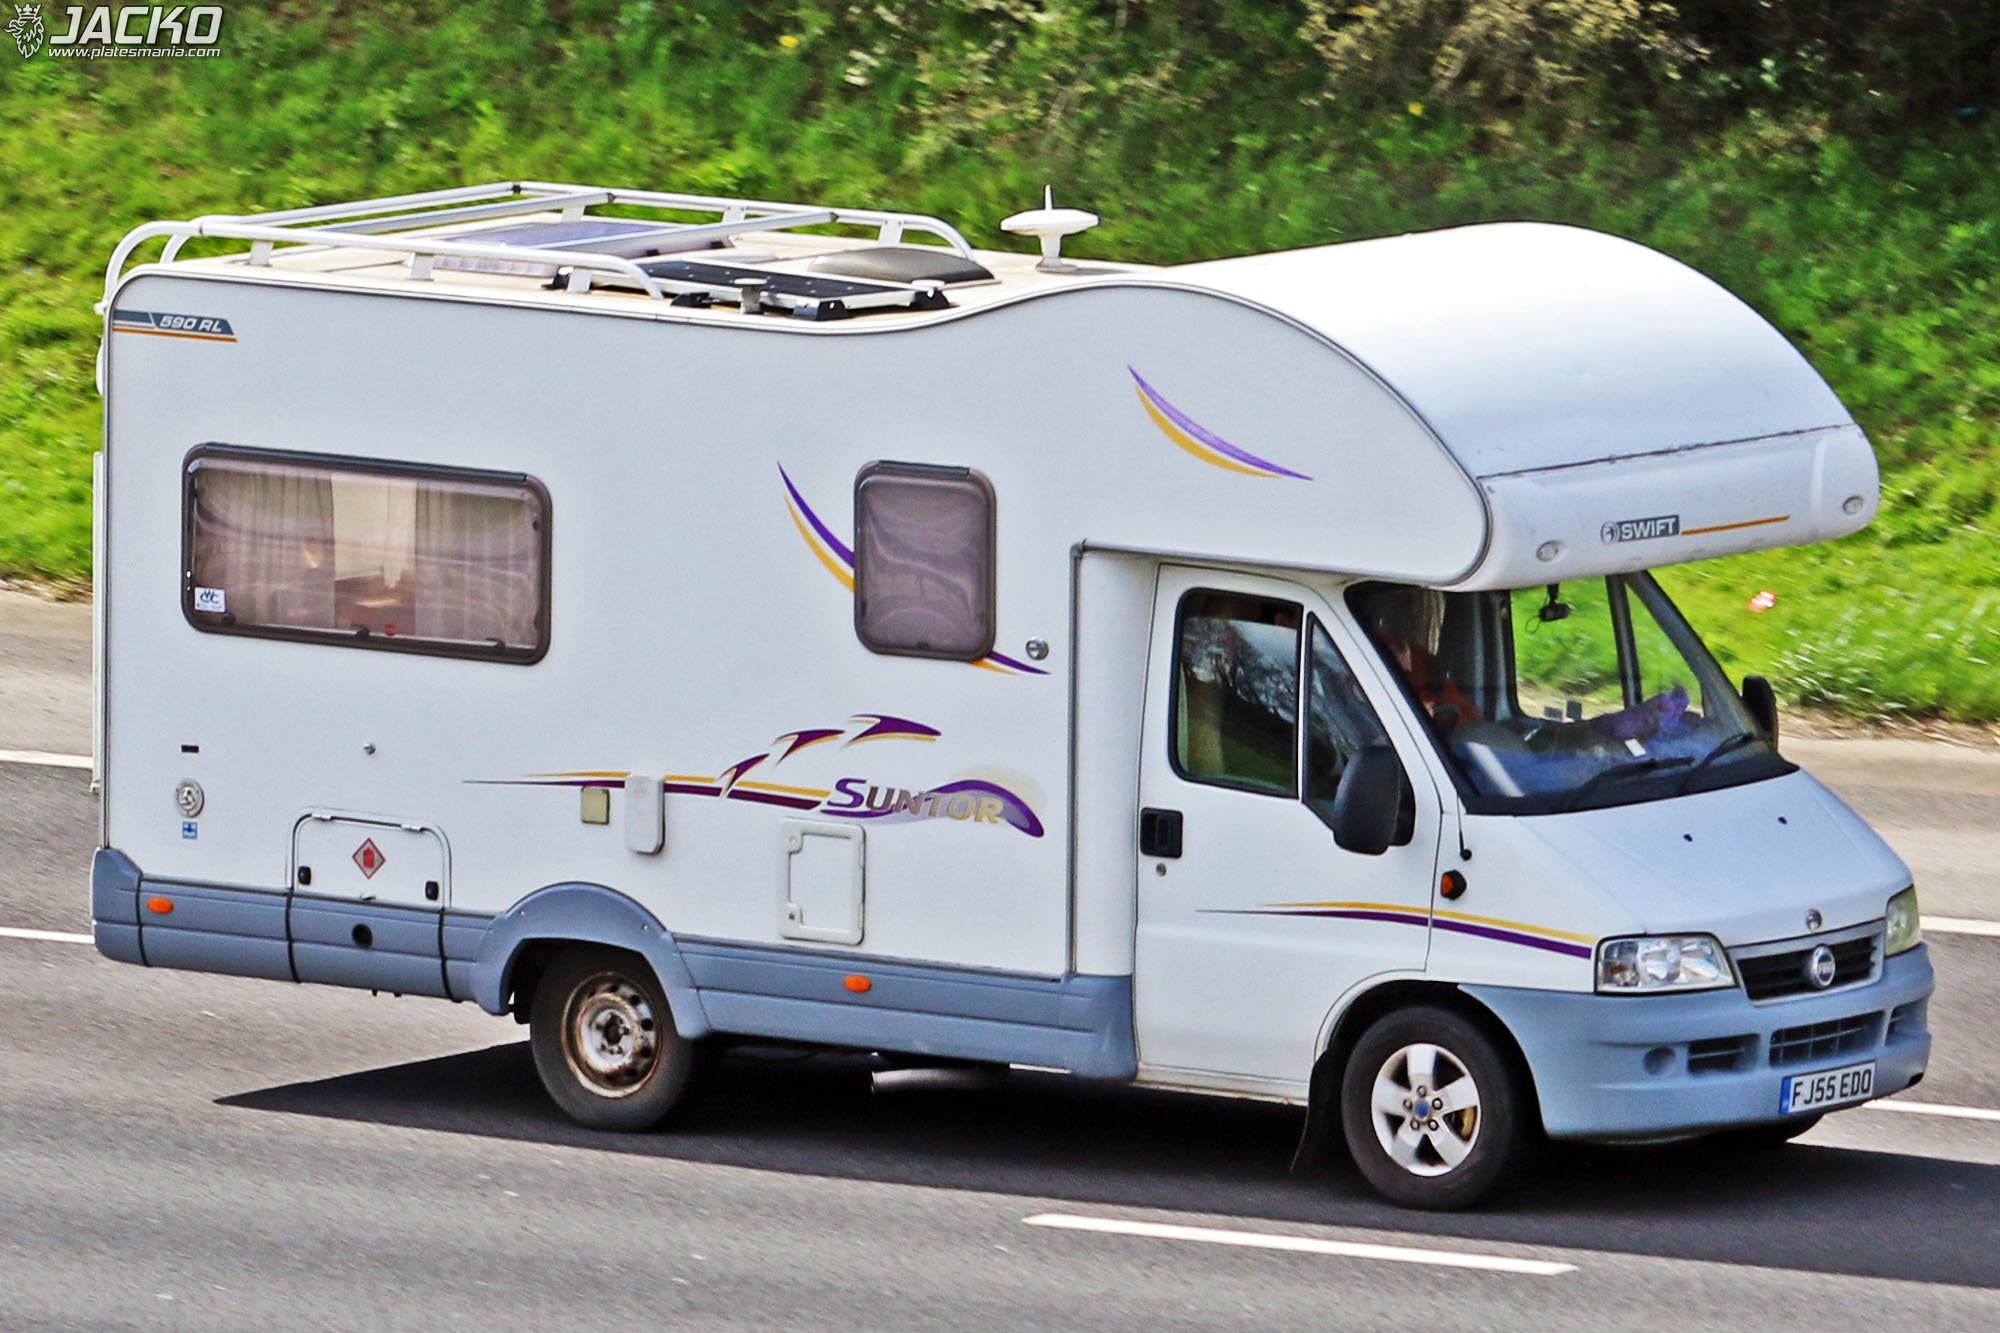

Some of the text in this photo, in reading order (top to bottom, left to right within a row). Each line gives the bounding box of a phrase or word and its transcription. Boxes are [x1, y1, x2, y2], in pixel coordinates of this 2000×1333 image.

[159, 315, 223, 333] 590 RL
[1621, 517, 1677, 541] SWIFT
[827, 777, 1004, 824] SUNTOR
[1791, 1069, 1872, 1107] FJ55 EDO
